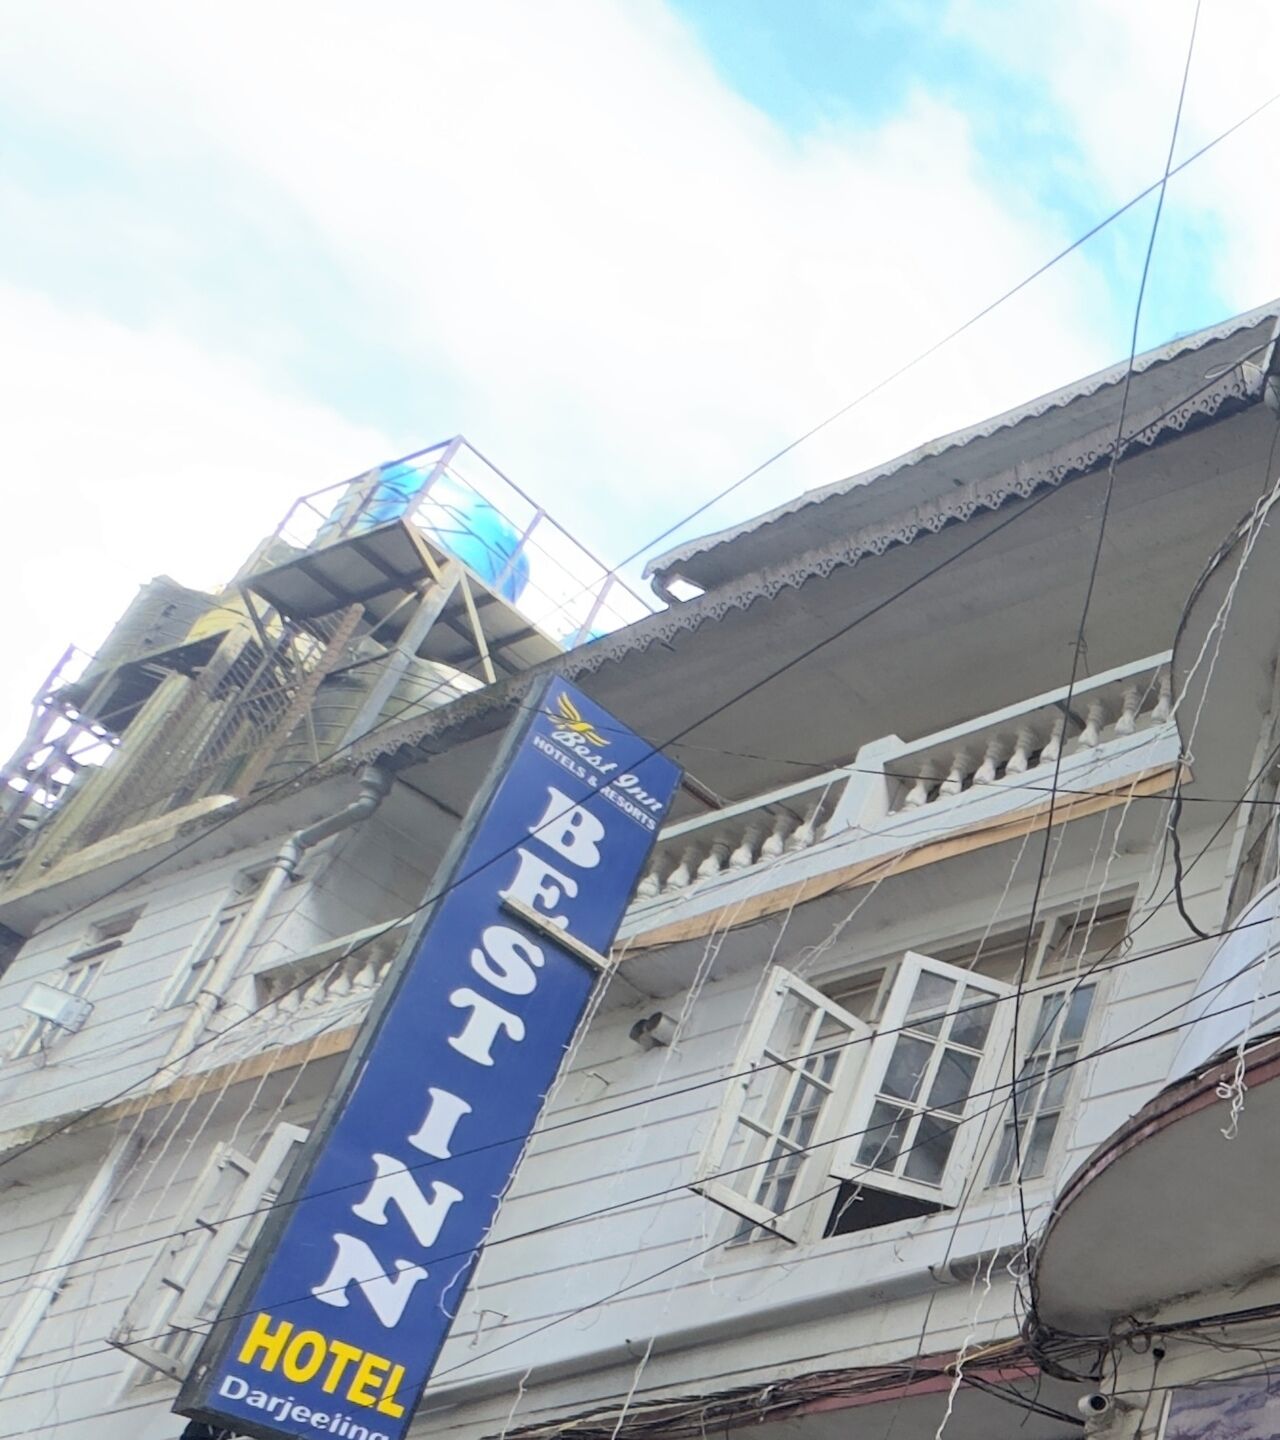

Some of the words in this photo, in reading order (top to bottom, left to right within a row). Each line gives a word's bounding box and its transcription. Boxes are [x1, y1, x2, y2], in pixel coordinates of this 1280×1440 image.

[533, 736, 587, 779] HOTELS
[587, 776, 599, 788] &
[600, 786, 657, 831] RESORTS
[551, 731, 618, 775] Best
[613, 774, 663, 812] Inn
[448, 786, 605, 1066] BEST
[311, 1087, 472, 1328] INN
[238, 1312, 405, 1419] HOTEL
